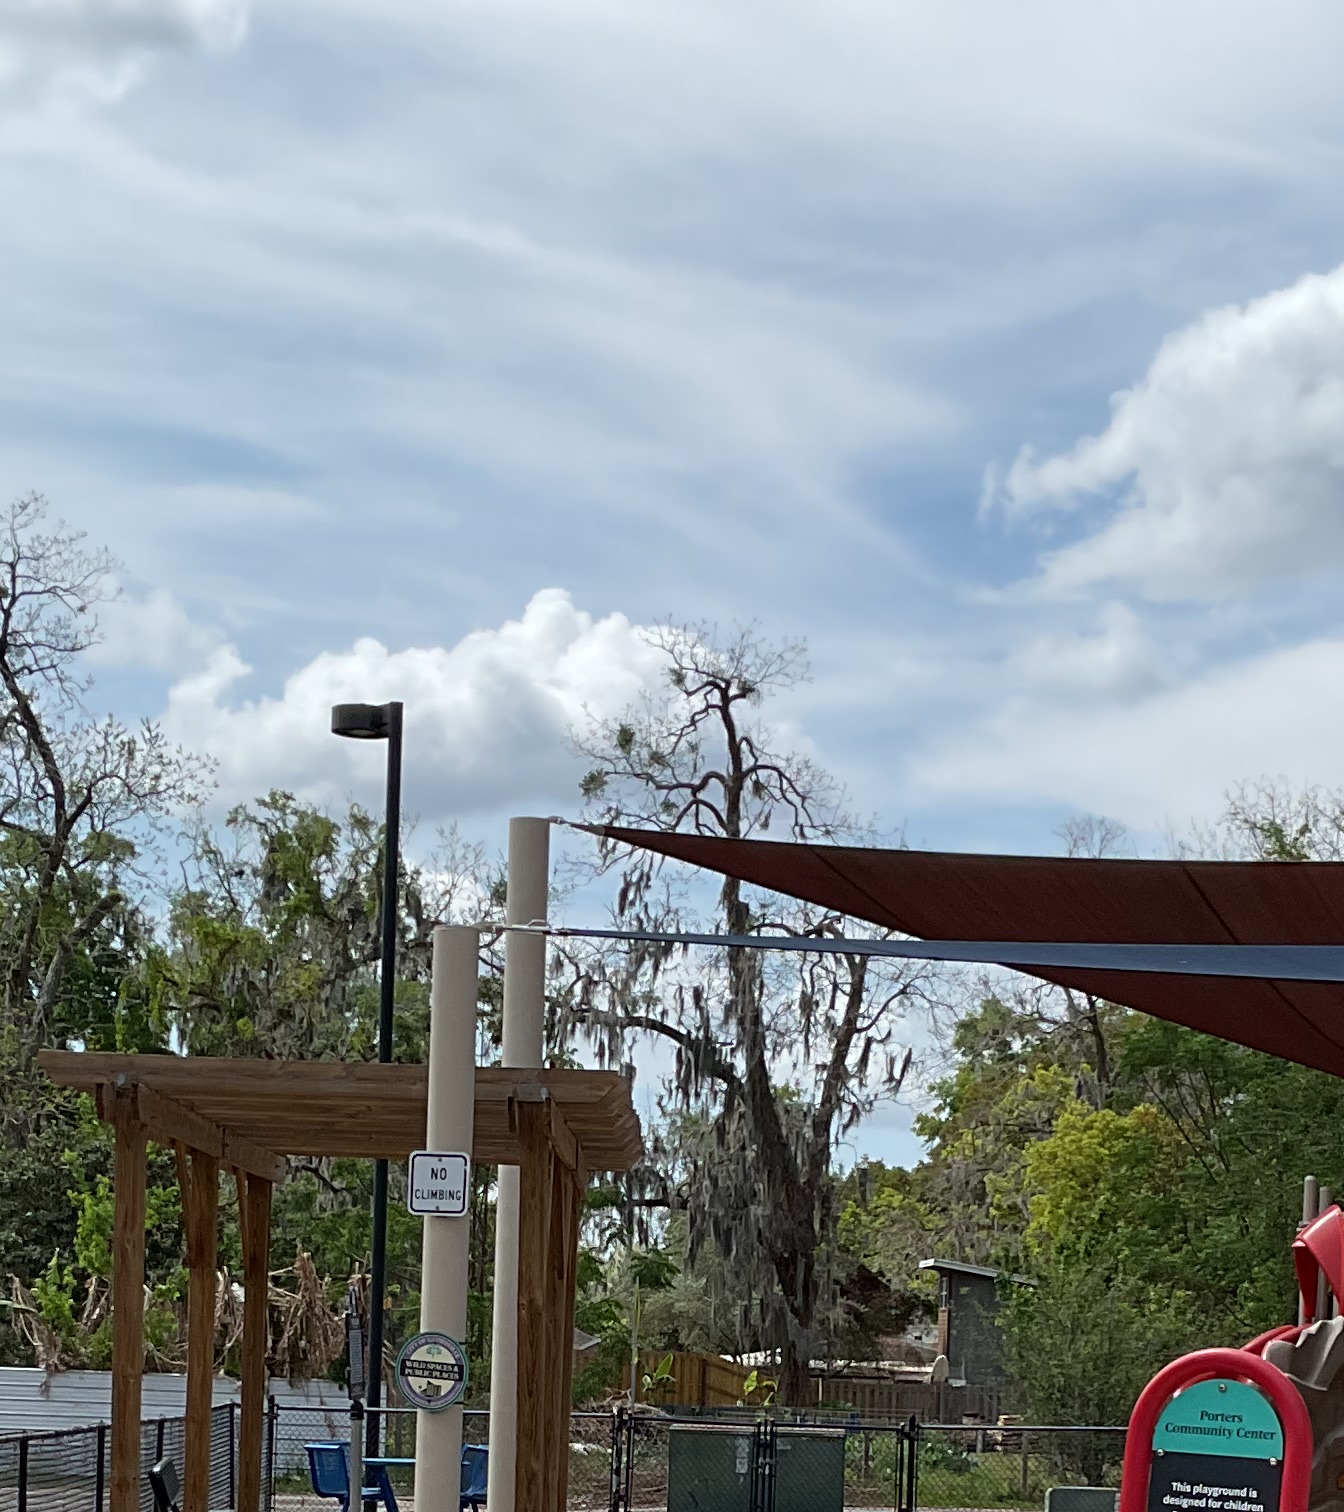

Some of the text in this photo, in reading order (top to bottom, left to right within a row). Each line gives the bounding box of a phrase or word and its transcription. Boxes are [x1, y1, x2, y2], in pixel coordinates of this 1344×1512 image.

[431, 1167, 447, 1180] NO
[415, 1189, 461, 1200] CLIMBING
[405, 1360, 426, 1369] WILD
[427, 1363, 452, 1371] SPACES
[405, 1368, 459, 1379] PUBLIC PLACES
[1200, 1410, 1243, 1423] Porters
[1165, 1422, 1276, 1440] Community Center
[1171, 1482, 1258, 1498] This playground is
[1163, 1495, 1264, 1512] designed for children
